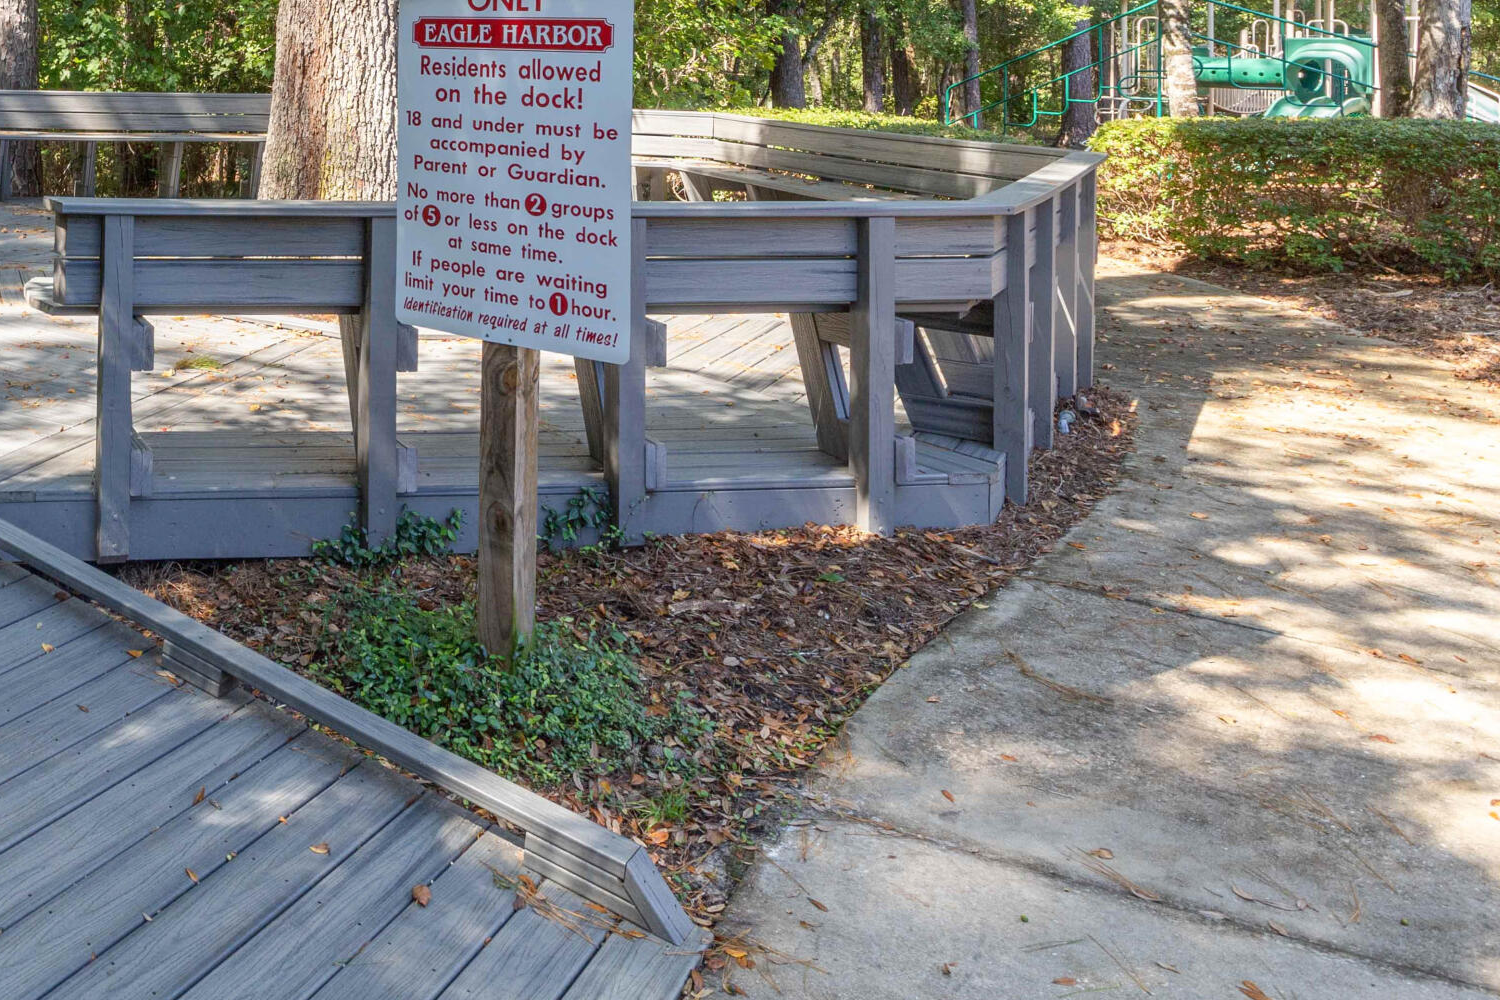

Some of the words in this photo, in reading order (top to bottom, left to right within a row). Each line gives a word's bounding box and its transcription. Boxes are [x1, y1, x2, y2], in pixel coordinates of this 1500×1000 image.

[424, 23, 492, 44] EAGLE
[502, 25, 603, 46] HARBOR
[420, 55, 506, 78] Residents
[518, 59, 601, 82] allowed
[436, 87, 460, 102] on
[474, 84, 506, 105] the
[521, 87, 583, 109] dock!
[406, 111, 422, 126] 18
[431, 114, 462, 129] and
[473, 118, 524, 134] under
[535, 122, 581, 138] must
[593, 122, 618, 140] be
[430, 138, 549, 159] accompanied
[561, 145, 585, 165] by
[414, 156, 467, 175] Parent
[478, 165, 496, 178] or
[508, 164, 606, 188] Guardian.
[407, 182, 428, 200] No
[436, 189, 475, 205] more
[484, 192, 520, 210] than
[530, 195, 541, 213] 2
[551, 203, 614, 222] groups
[404, 205, 419, 222] of
[427, 207, 436, 224] 5
[445, 214, 460, 226] or
[469, 214, 497, 232] less
[508, 222, 528, 235] on
[538, 223, 565, 240] the
[576, 225, 618, 247] dock
[448, 236, 464, 249] at
[471, 240, 511, 257] same
[521, 245, 563, 263] time.
[412, 251, 422, 266] If
[431, 257, 486, 279] people
[496, 268, 524, 283] are
[537, 273, 607, 299] waiting
[405, 272, 434, 292] limit
[442, 282, 476, 300] your
[484, 286, 518, 307] time
[529, 295, 545, 310] to
[556, 296, 562, 313] 1
[571, 299, 616, 321] hour.
[404, 298, 473, 322] Identification
[478, 310, 528, 334] required
[534, 321, 548, 334] at
[554, 322, 570, 339] all
[576, 328, 618, 347] times!
